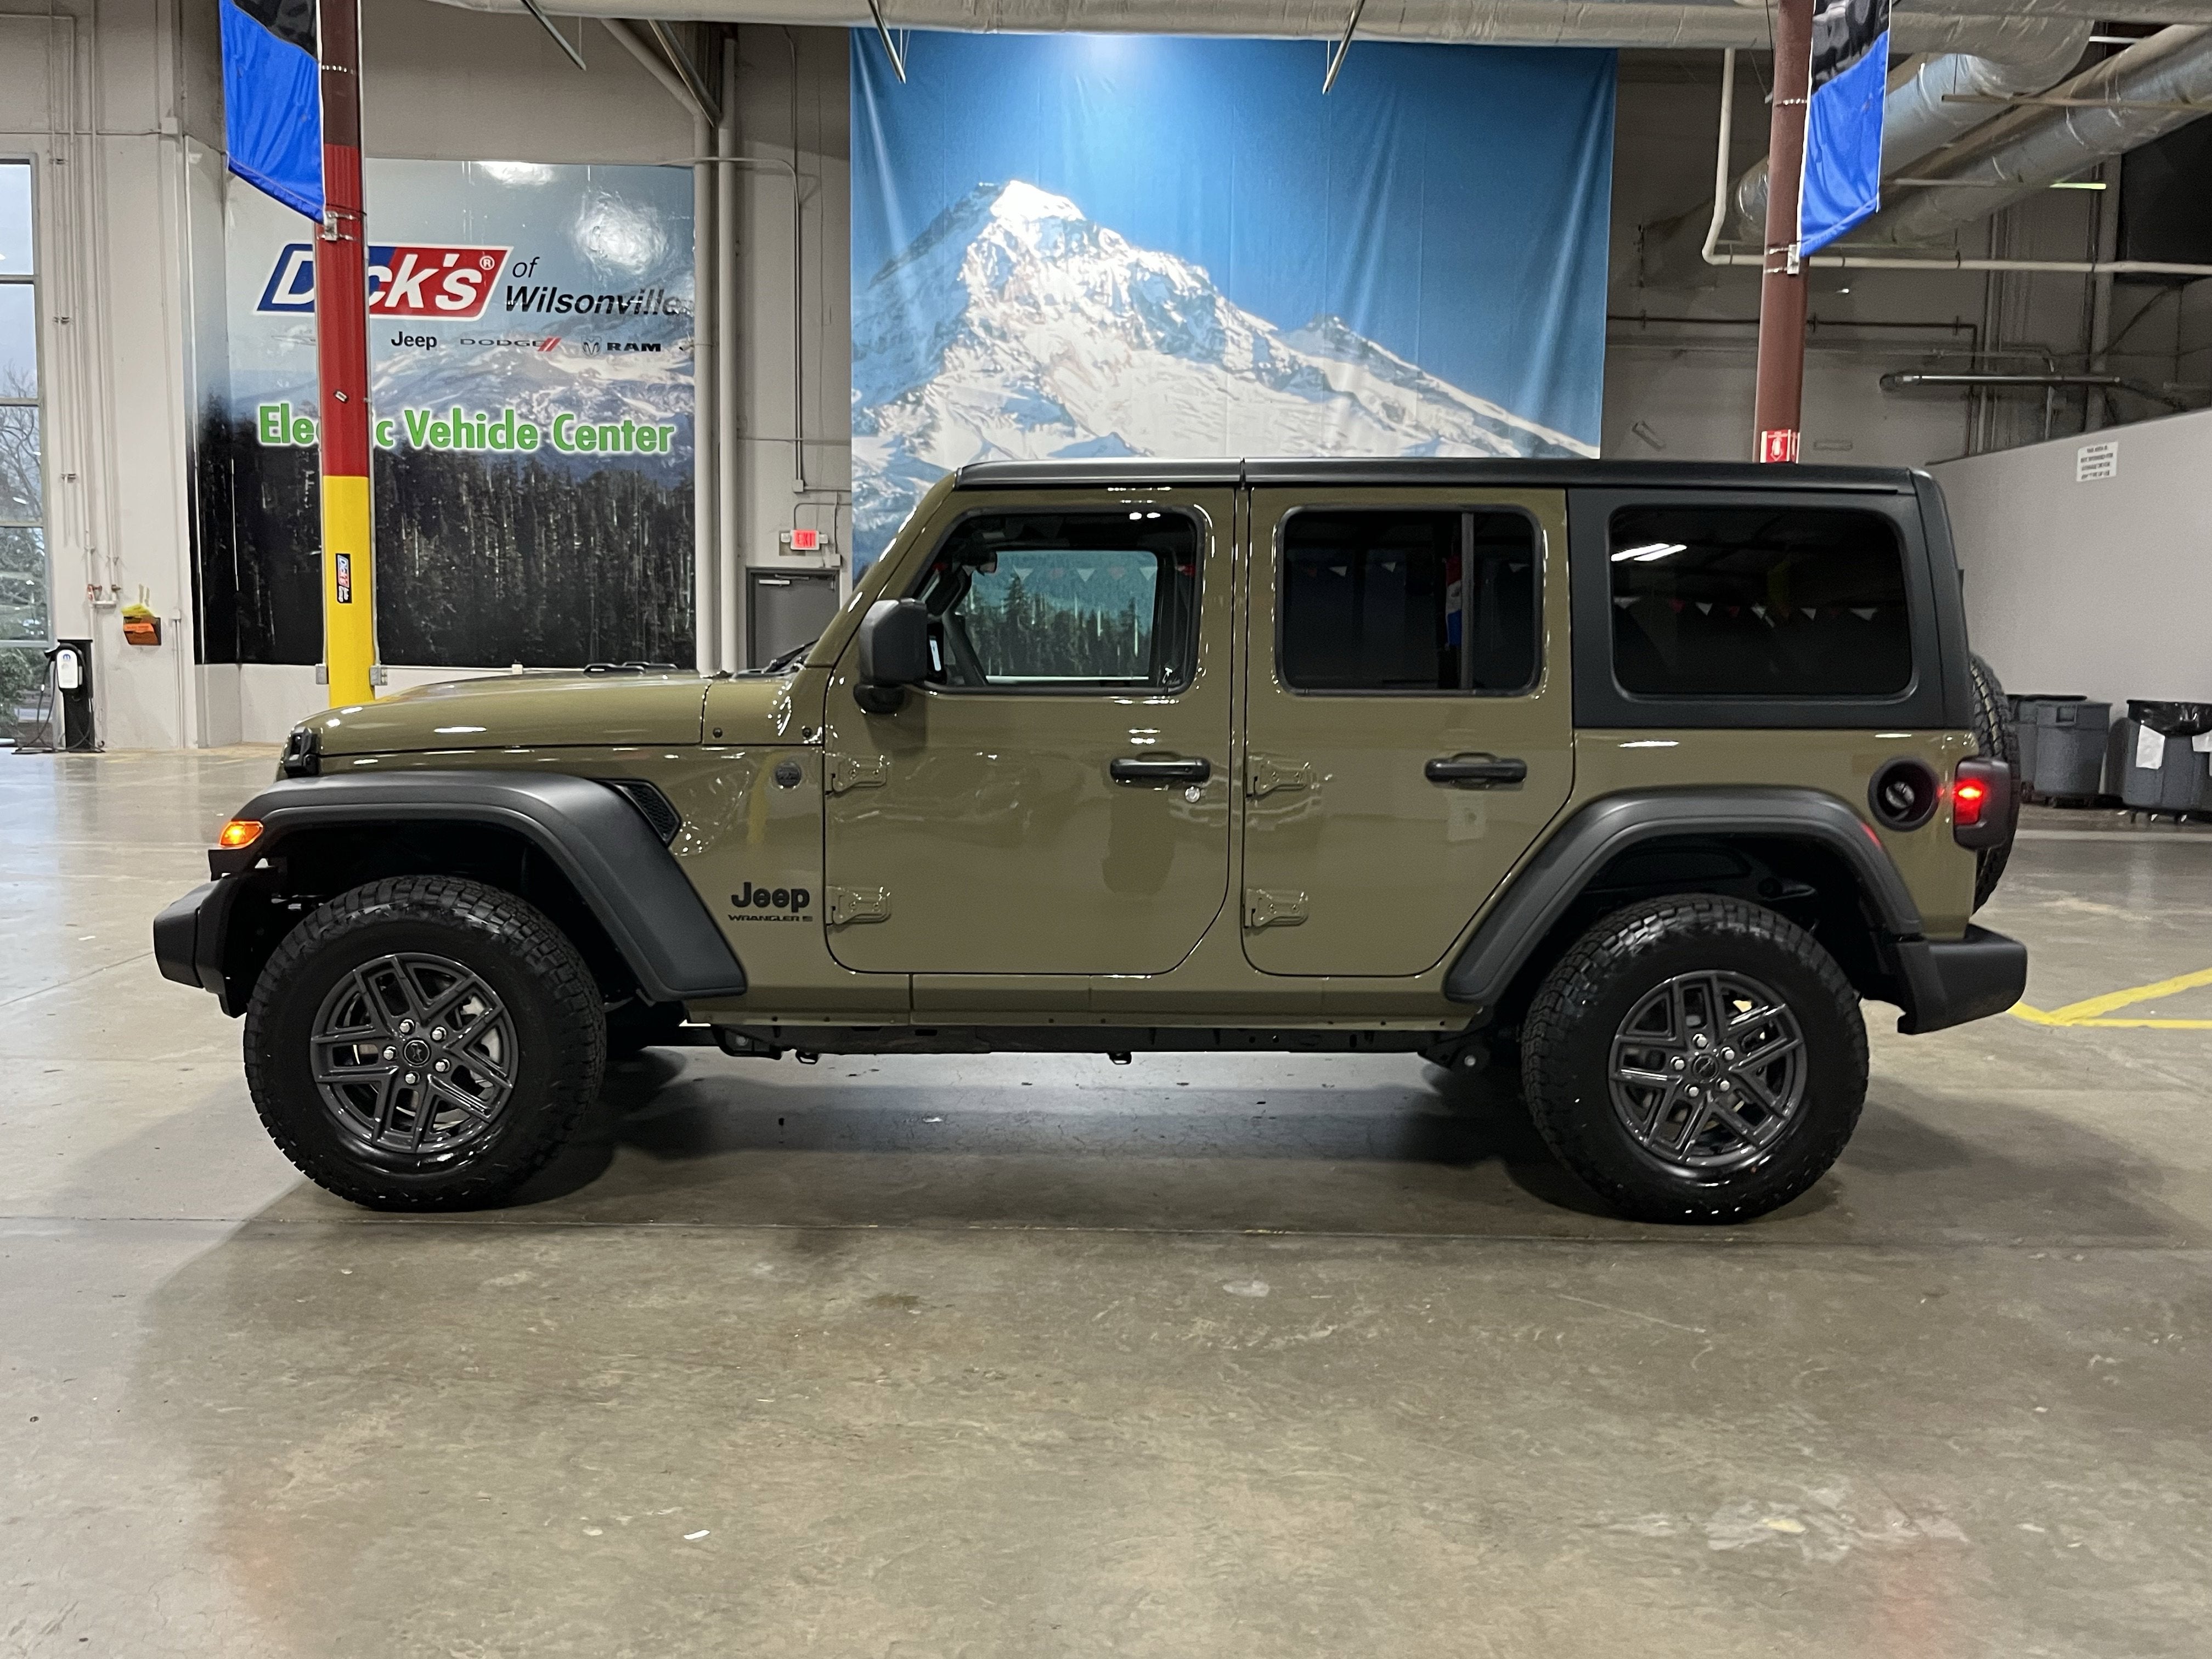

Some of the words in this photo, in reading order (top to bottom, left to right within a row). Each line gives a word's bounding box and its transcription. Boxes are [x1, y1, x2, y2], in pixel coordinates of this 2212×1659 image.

[512, 257, 540, 278] of
[272, 251, 483, 311] Dck's
[506, 285, 681, 315] Wilsonville
[391, 331, 437, 351] Jeep
[607, 342, 662, 352] RAM
[259, 403, 394, 447] Elec
[404, 408, 538, 450] Vehicle
[553, 414, 675, 453] Center
[797, 533, 816, 547] EXIT
[731, 882, 810, 913] Jeep
